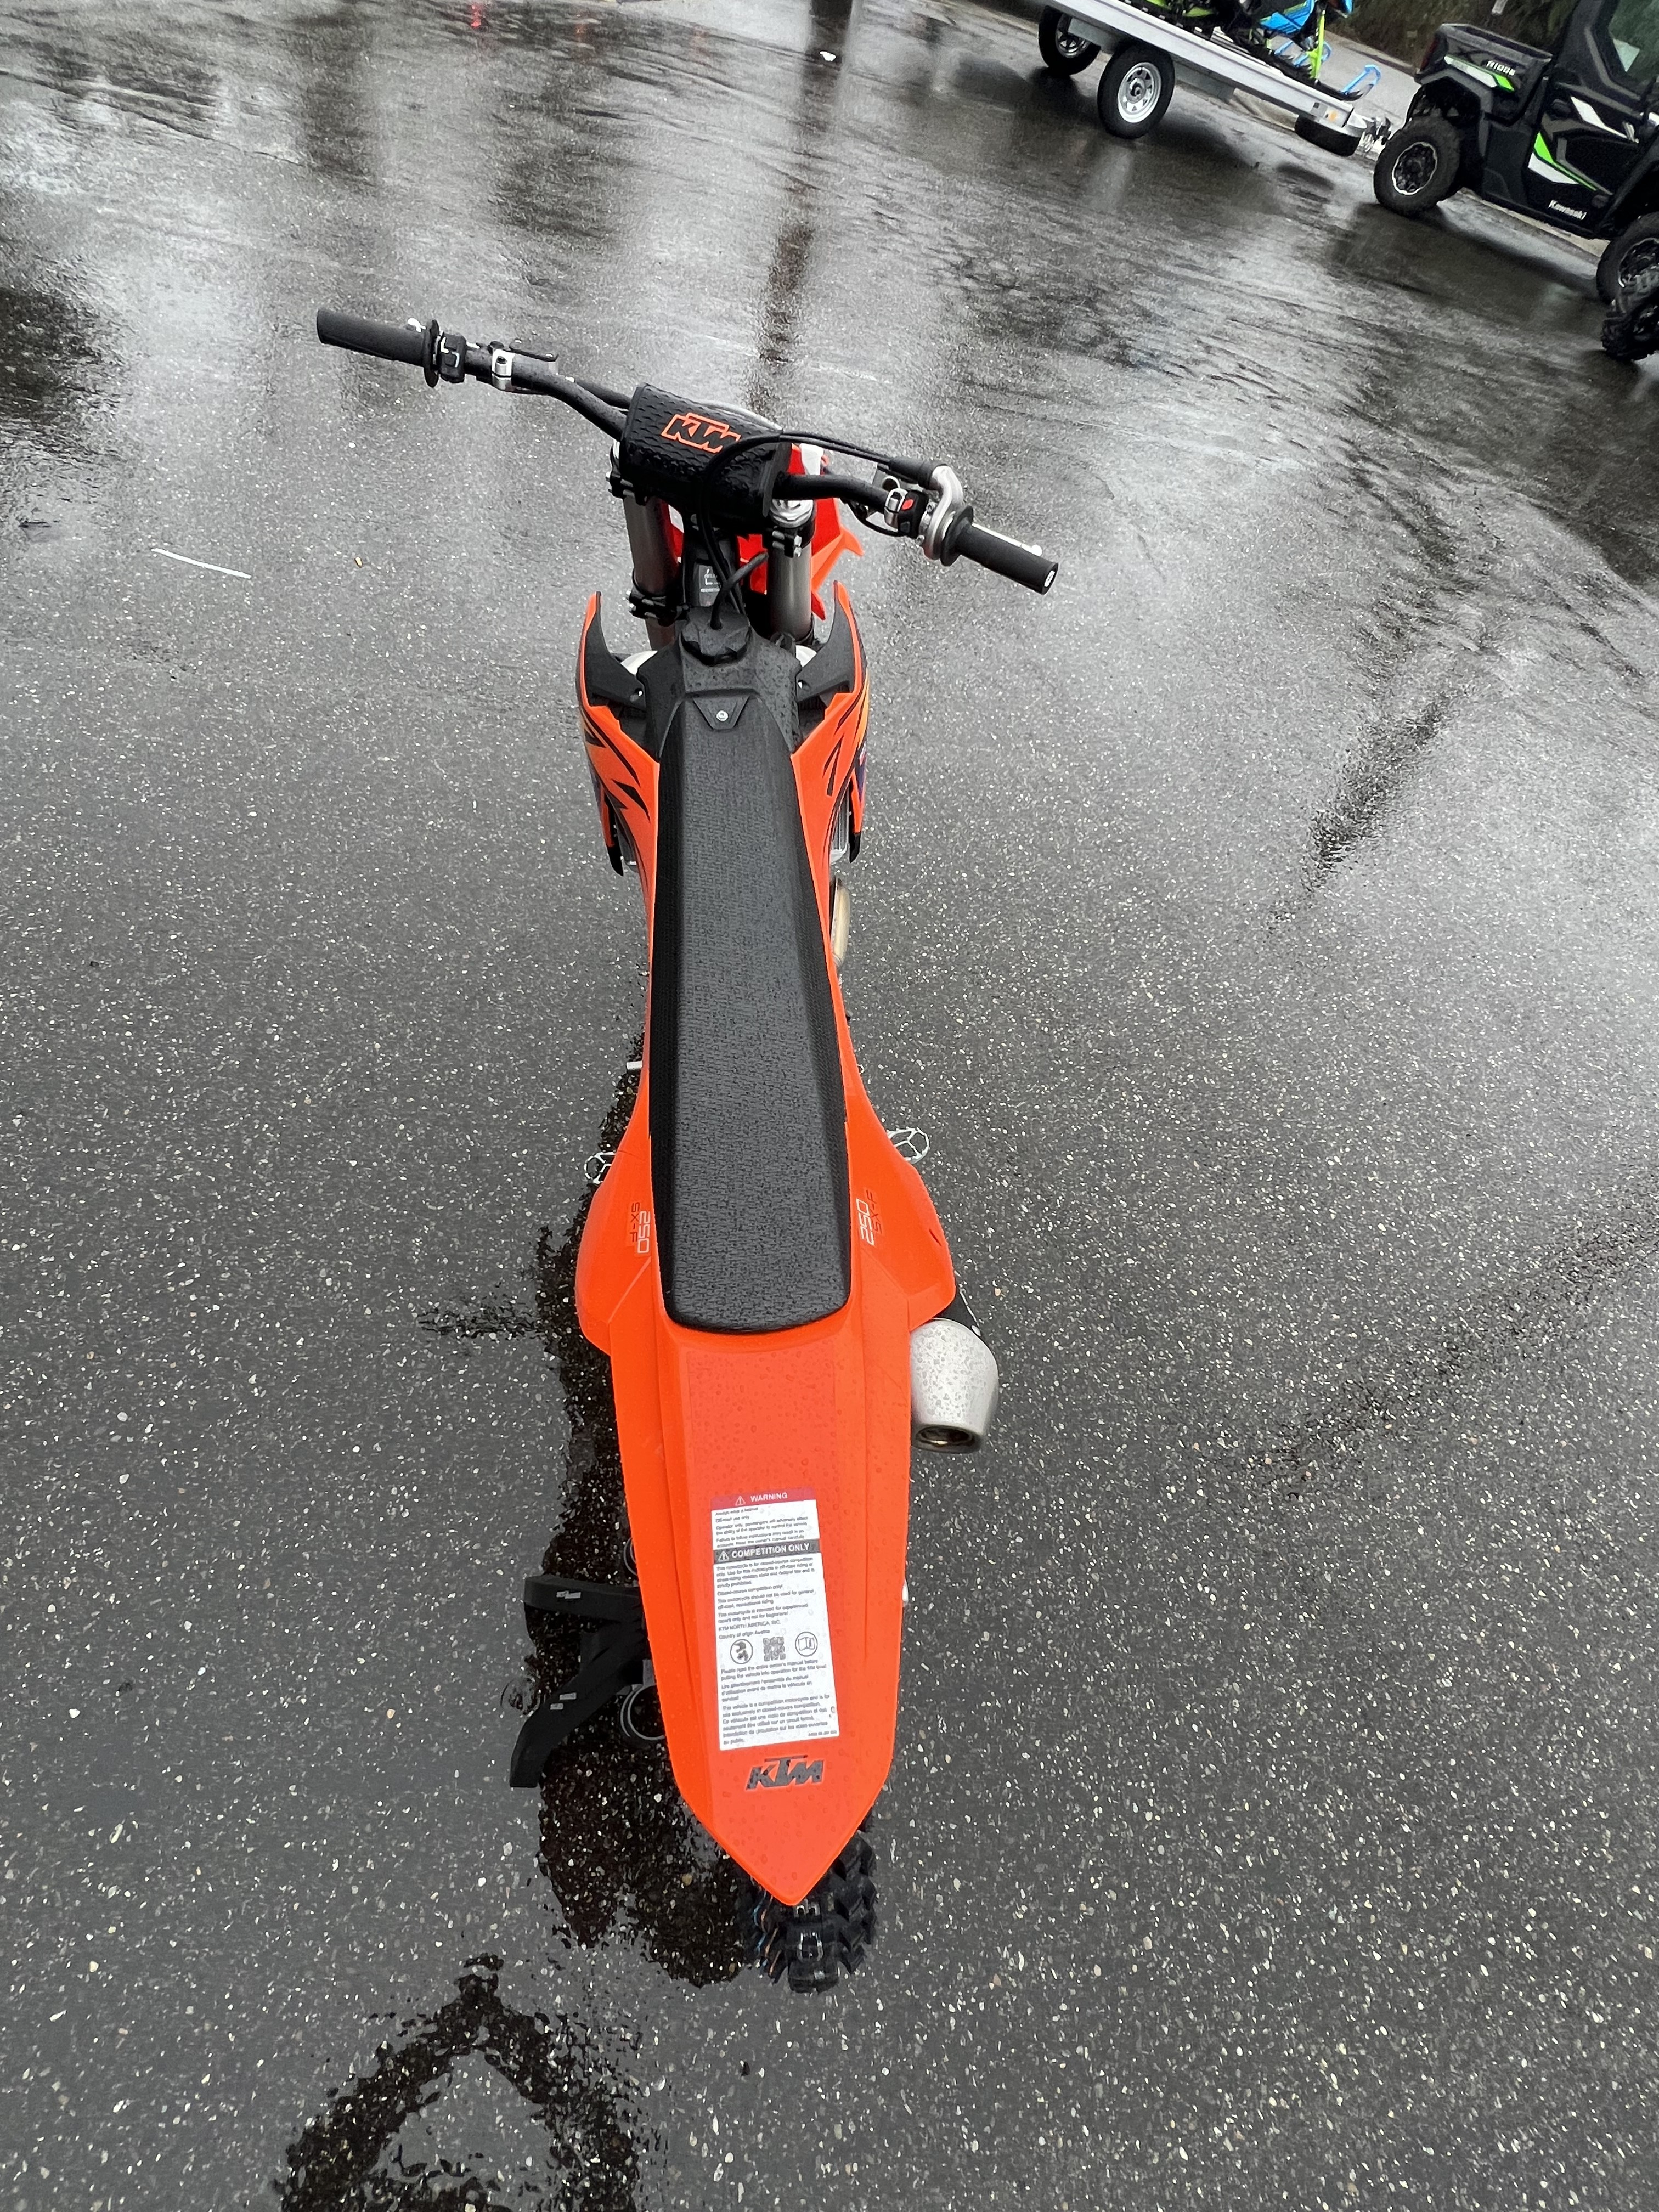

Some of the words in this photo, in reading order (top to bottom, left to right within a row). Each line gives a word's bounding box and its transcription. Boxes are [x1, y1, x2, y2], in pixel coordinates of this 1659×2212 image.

[1548, 200, 1587, 221] Kawasaki
[661, 413, 741, 453] KTM
[637, 1210, 651, 1254] 250
[856, 1198, 874, 1246] 250
[751, 1492, 788, 1502] WARNING
[731, 1544, 787, 1559] COMPETITION
[788, 1543, 810, 1553] ONLY
[746, 1754, 825, 1790] KTM
